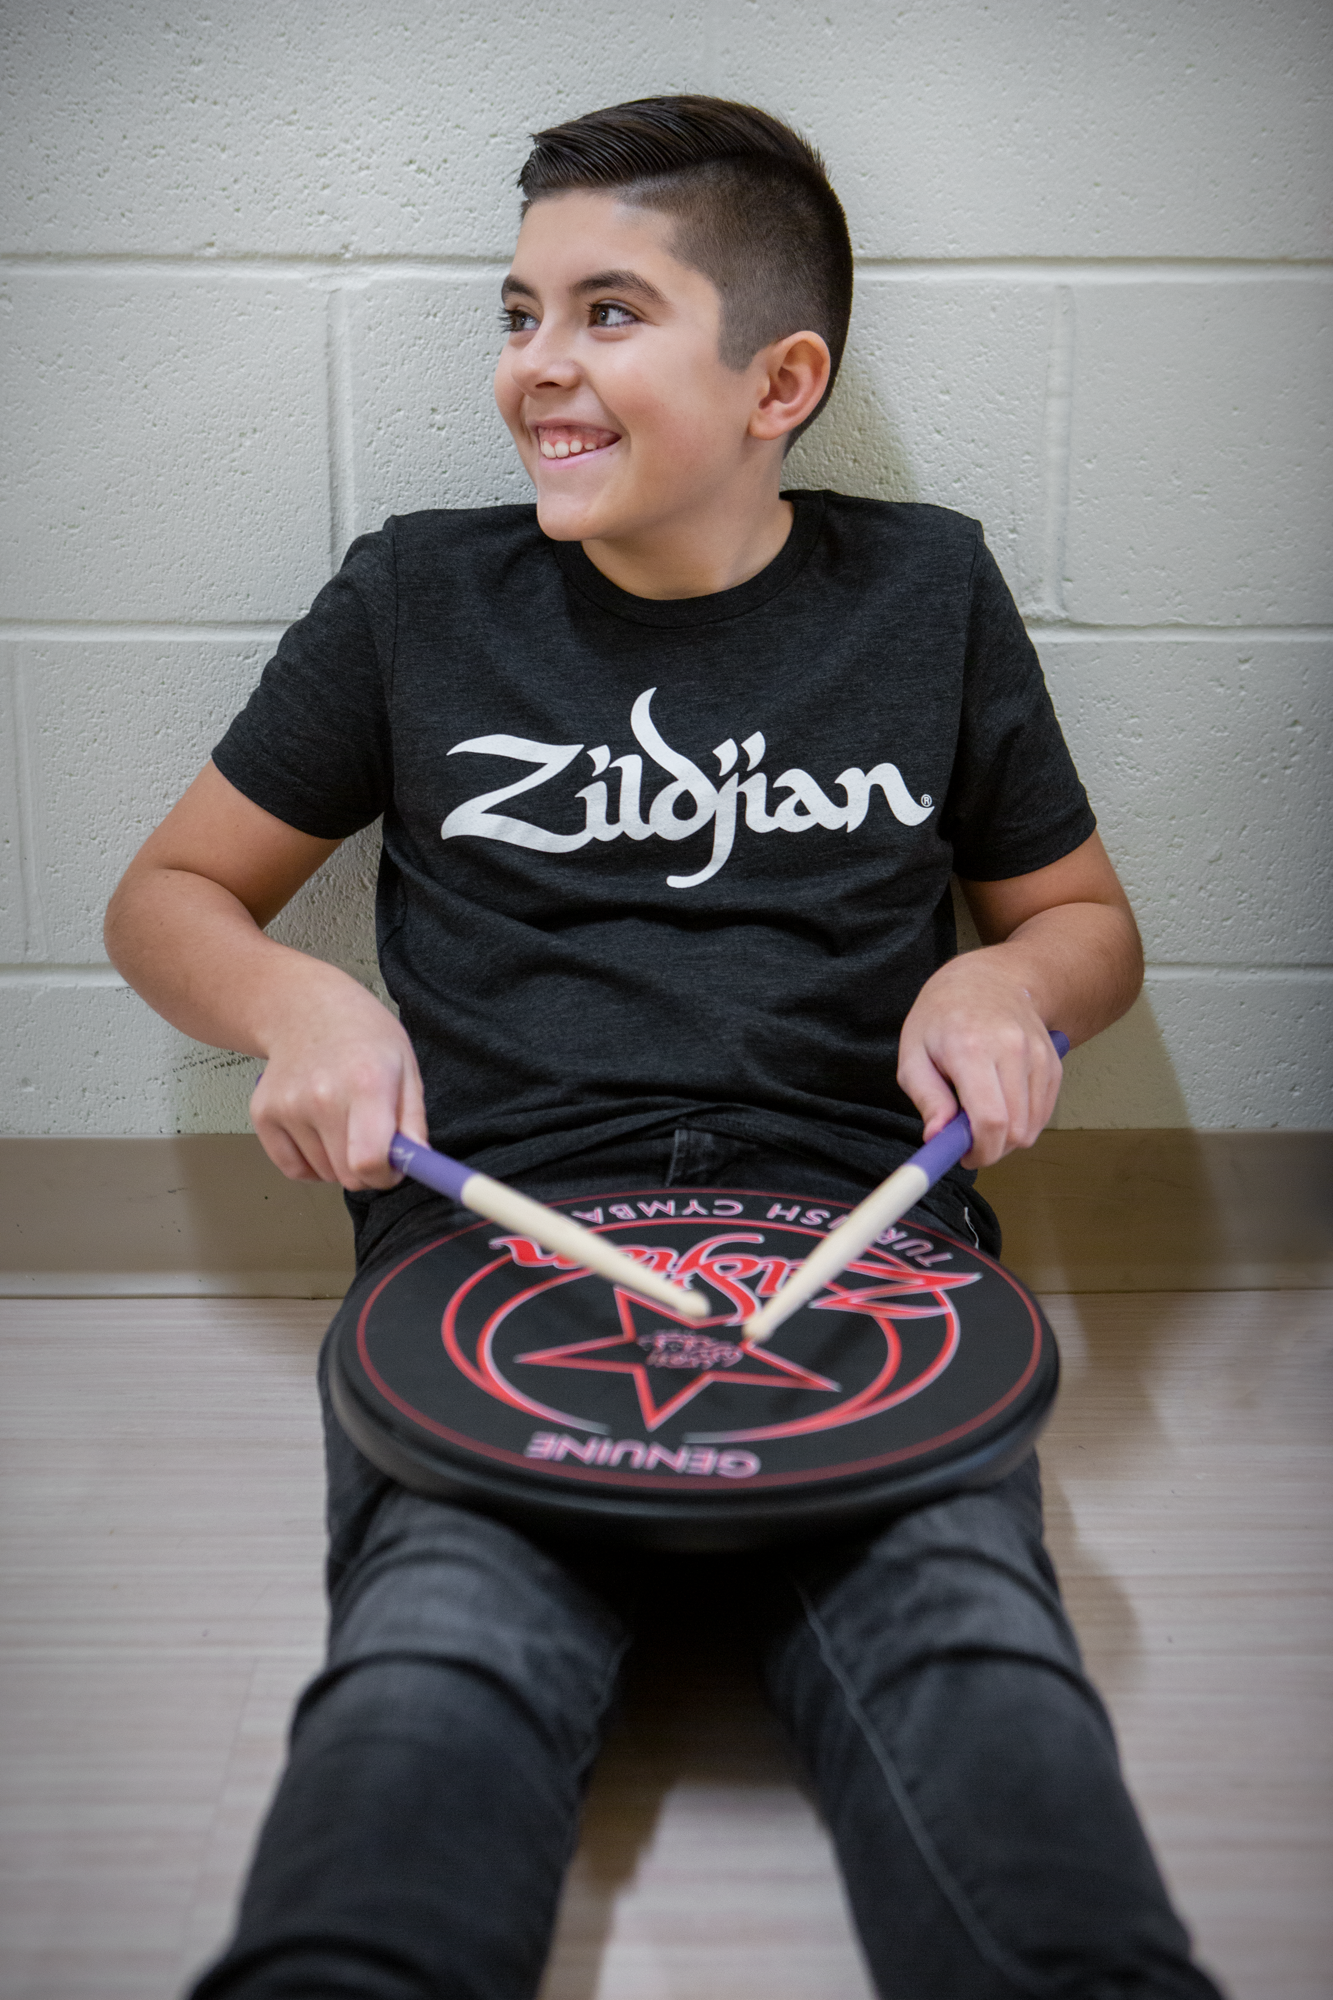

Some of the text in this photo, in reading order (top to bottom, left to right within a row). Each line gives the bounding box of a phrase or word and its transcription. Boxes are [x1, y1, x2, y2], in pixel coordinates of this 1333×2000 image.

[560, 1200, 953, 1267] TURISH CYMBA
[523, 1431, 761, 1479] GENUINE
